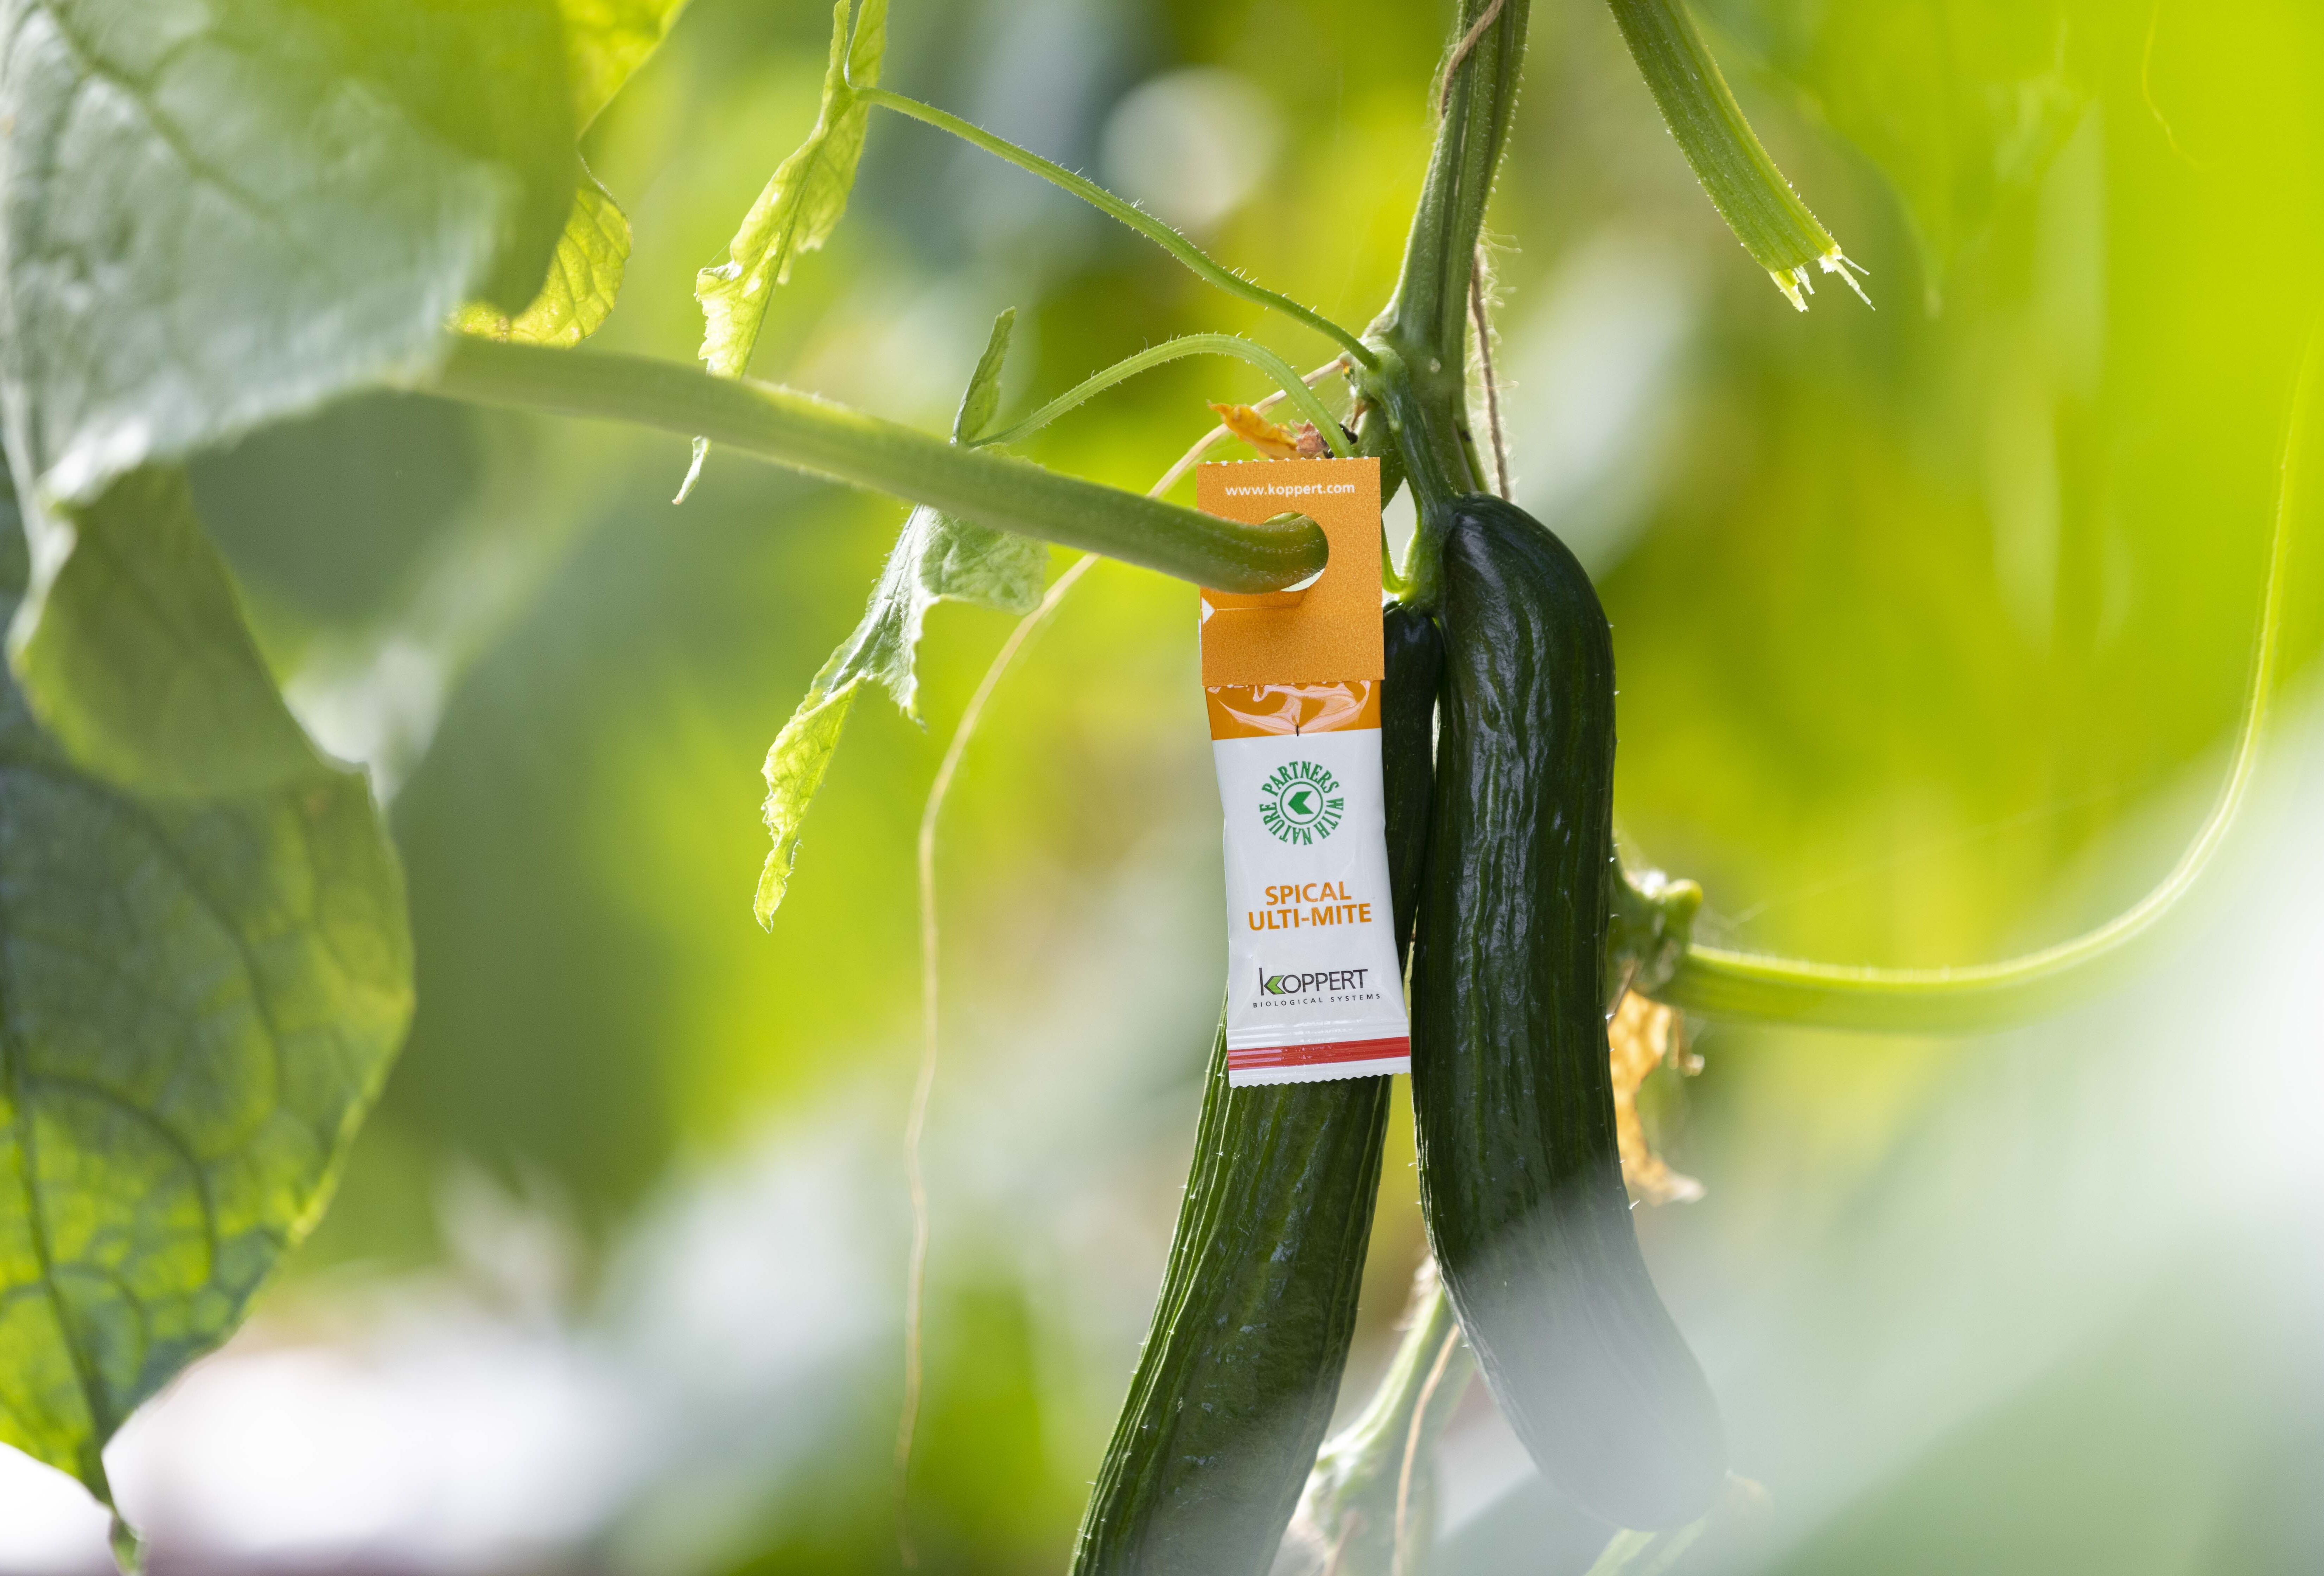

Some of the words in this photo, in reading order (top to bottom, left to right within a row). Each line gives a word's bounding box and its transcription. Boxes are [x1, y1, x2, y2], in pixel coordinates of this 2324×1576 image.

[1226, 483, 1355, 497] www.koppert.com
[1262, 761, 1339, 797] PARTNERS
[1259, 802, 1313, 845] NATURE
[1313, 797, 1344, 839] WITH
[1266, 881, 1351, 906] SPICAL
[1248, 903, 1371, 930] ULTI-MITE
[1253, 998, 1323, 1008] BIOLOGICAL
[1331, 993, 1381, 1002] SYSTEMS
